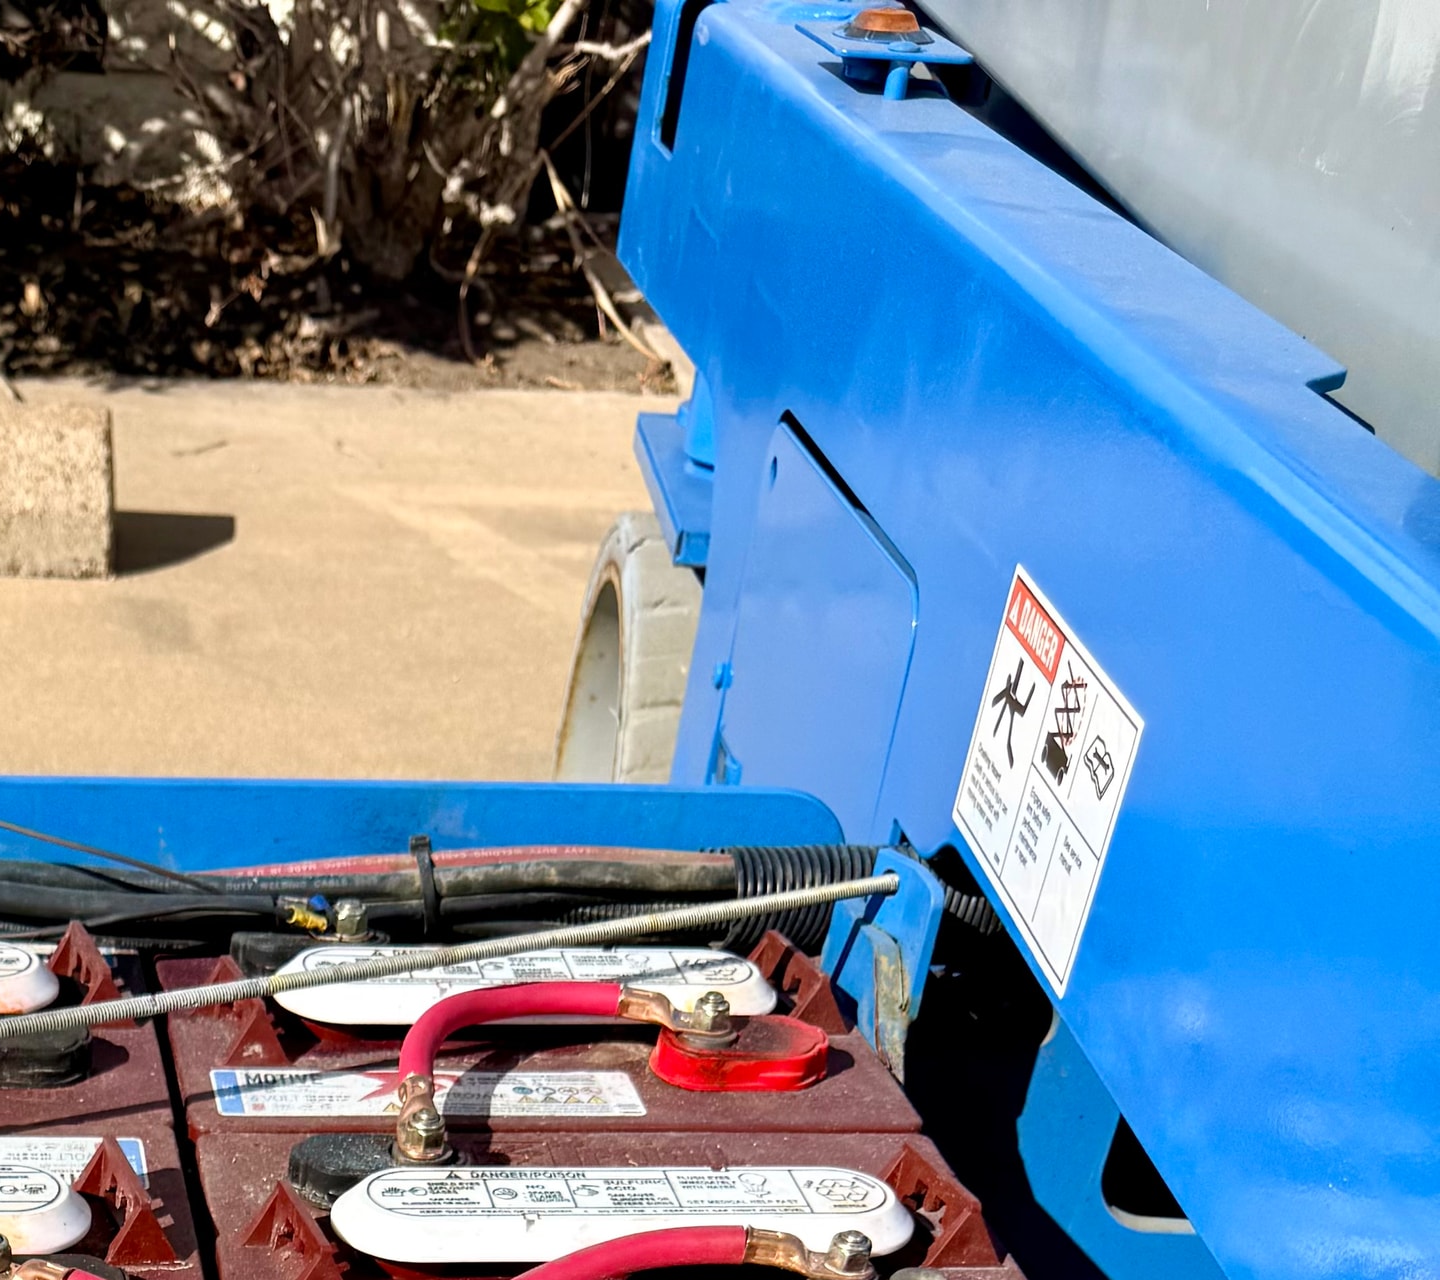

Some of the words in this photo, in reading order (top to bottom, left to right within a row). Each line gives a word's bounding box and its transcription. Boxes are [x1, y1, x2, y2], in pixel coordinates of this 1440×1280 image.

[1019, 598, 1058, 672] DANGER
[1029, 786, 1042, 812] Engage
[1022, 815, 1038, 847] performing
[1032, 809, 1042, 830] before
[245, 1072, 324, 1086] MOTIVE
[470, 1171, 586, 1179] DANGER/POISON
